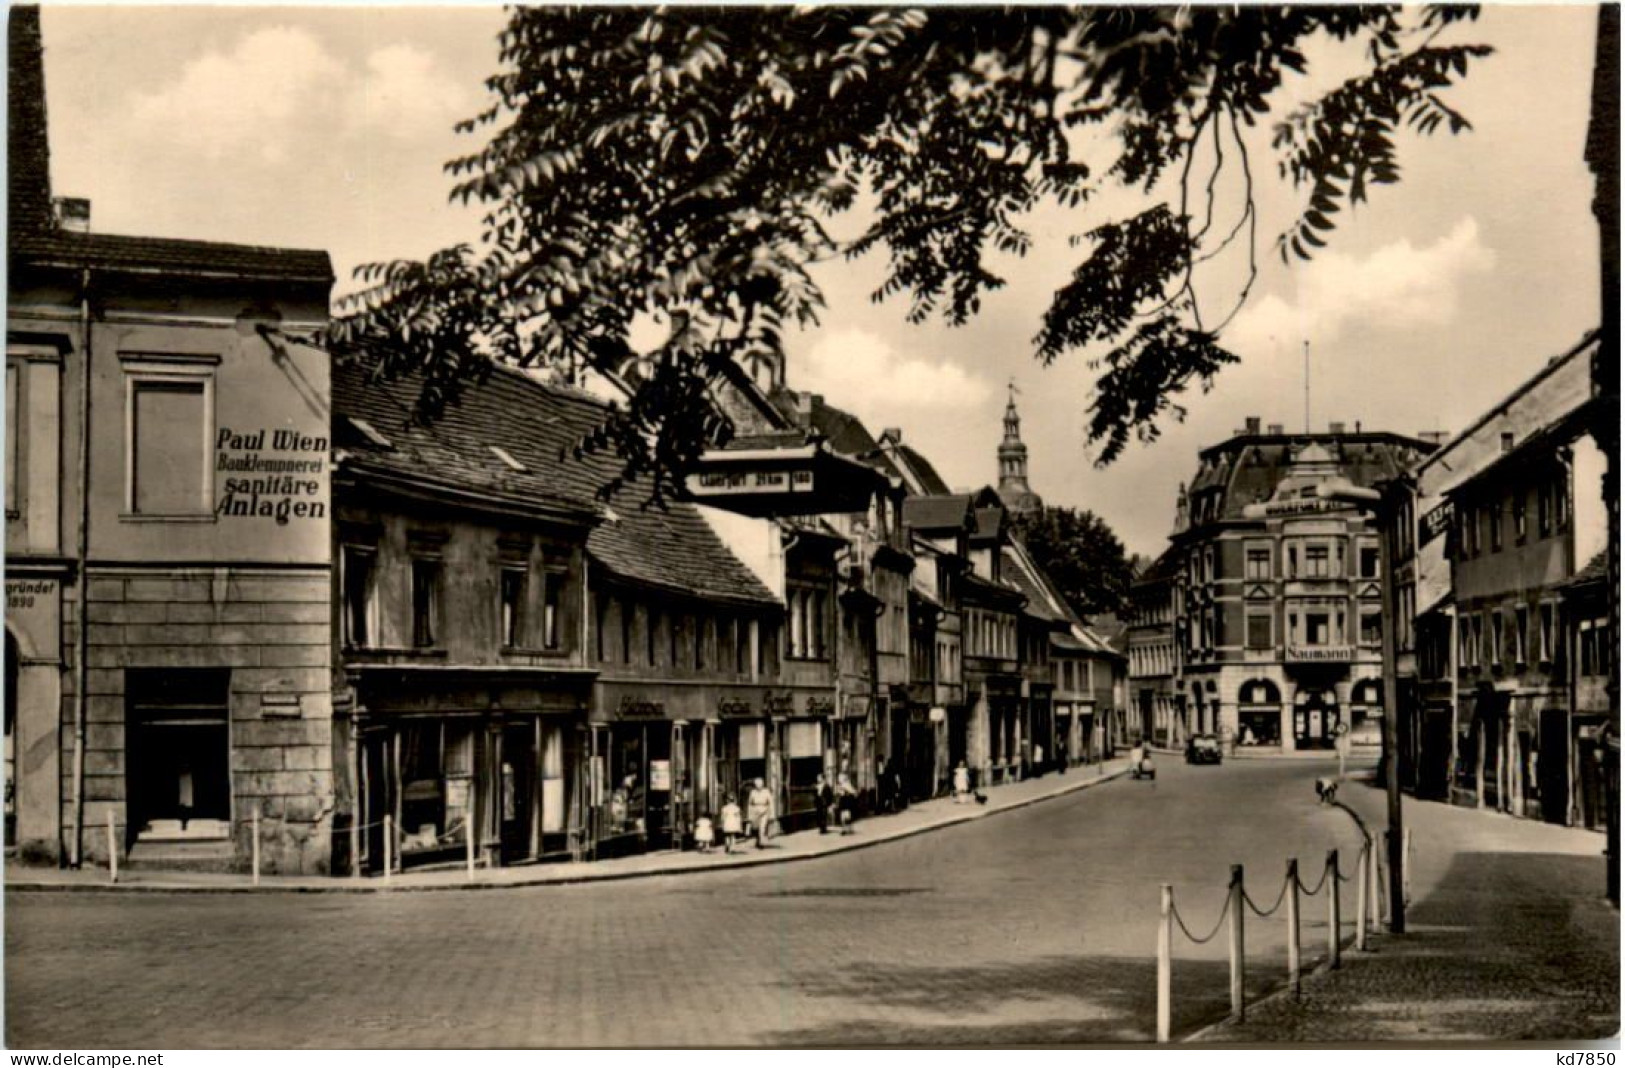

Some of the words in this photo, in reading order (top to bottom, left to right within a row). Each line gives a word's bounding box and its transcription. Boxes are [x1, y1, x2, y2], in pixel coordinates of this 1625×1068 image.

[217, 428, 265, 450] Paul
[273, 430, 328, 452] Wien
[224, 475, 319, 495] sanitäre
[214, 494, 326, 526] Anlagen
[1287, 646, 1348, 660] Naumann
